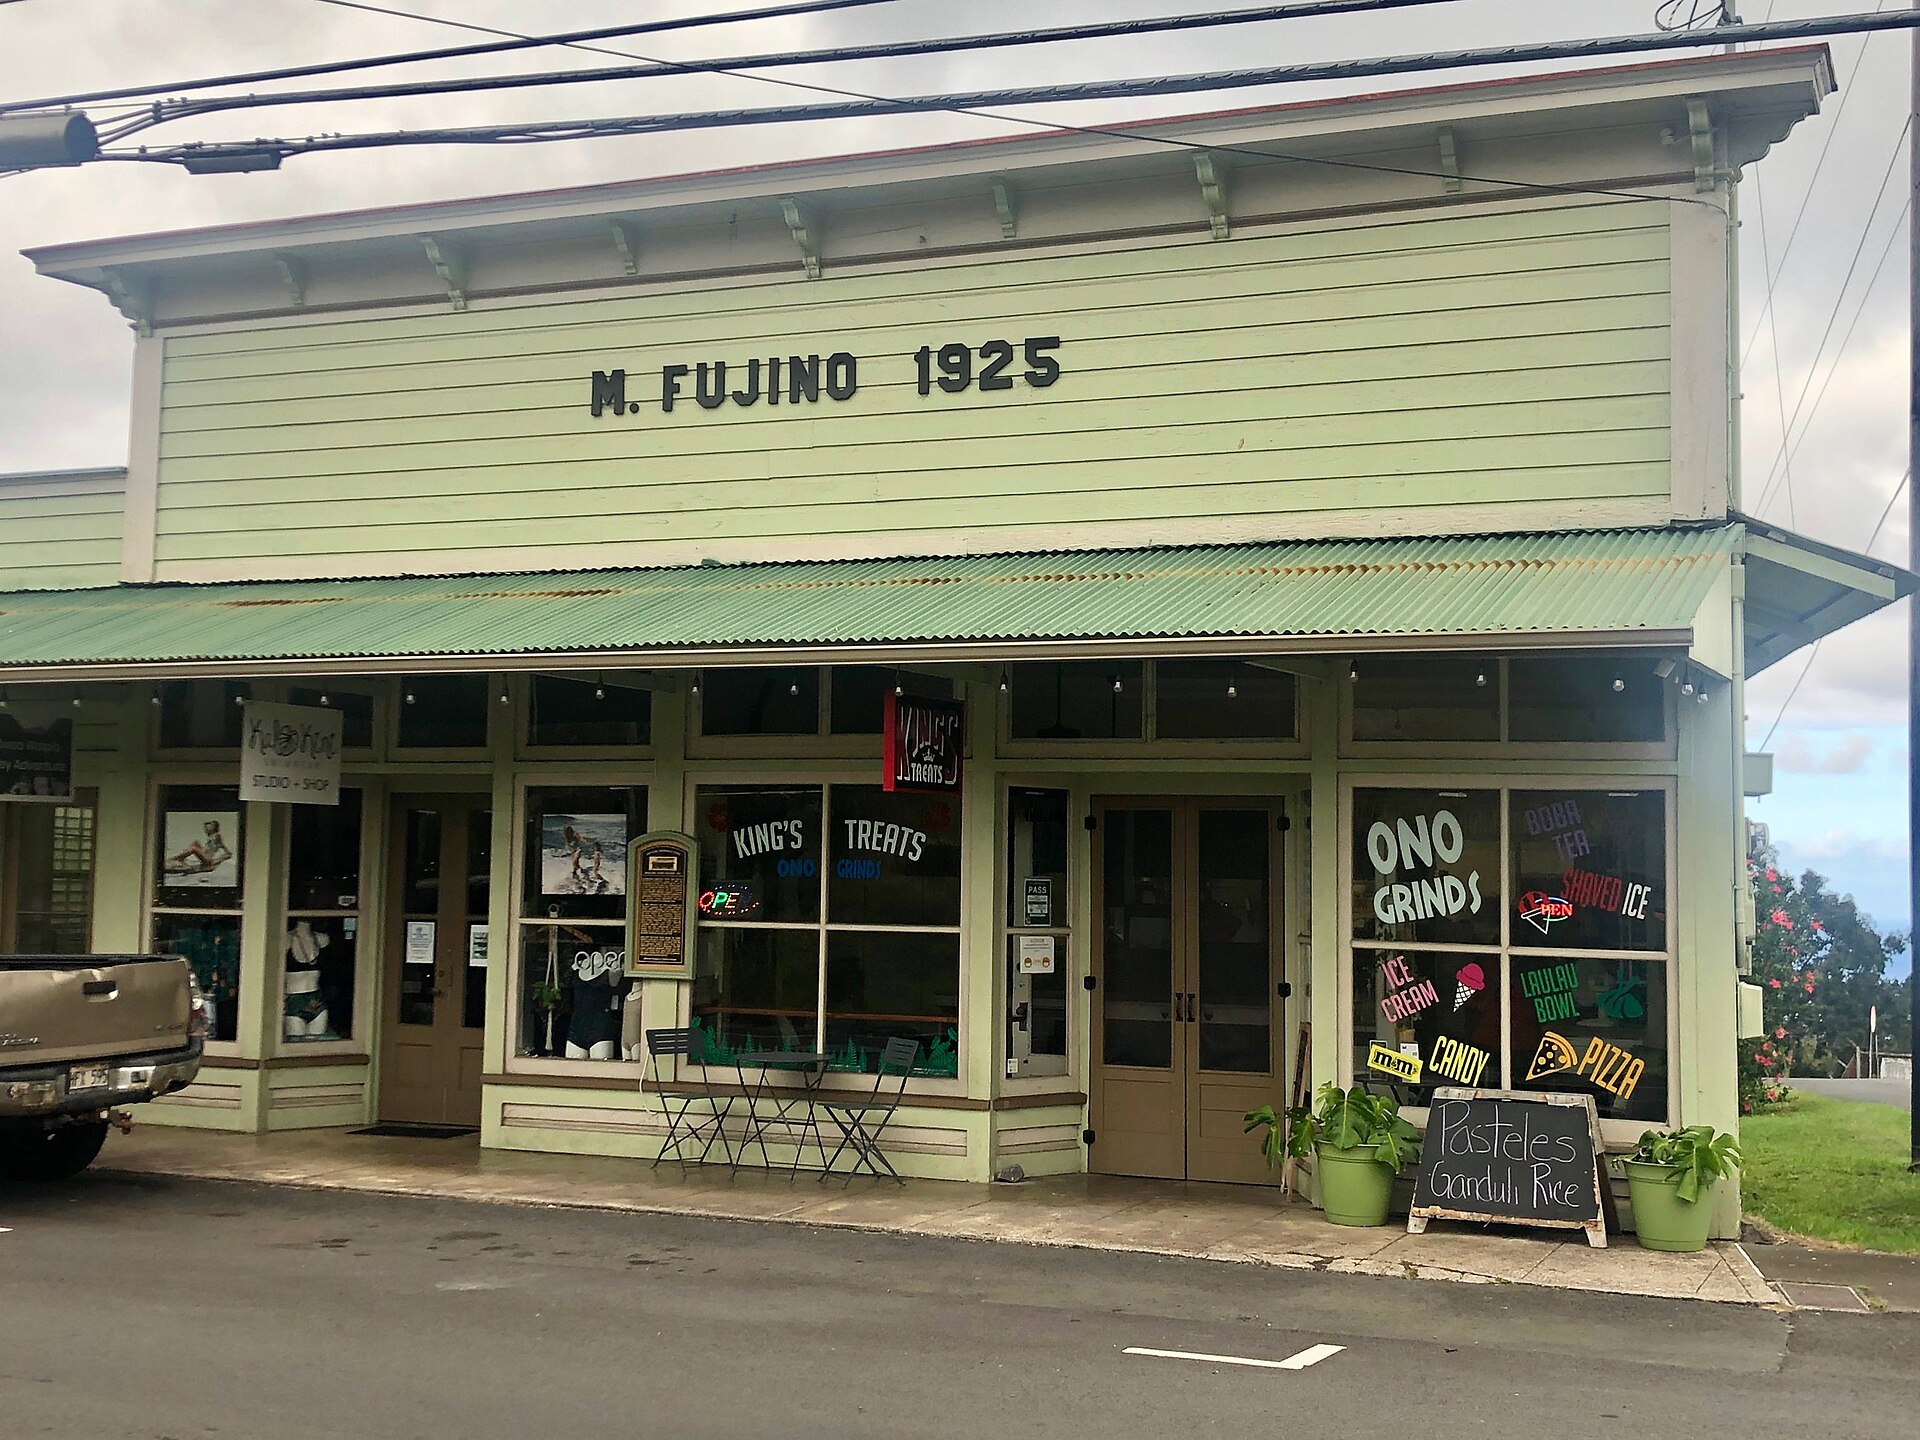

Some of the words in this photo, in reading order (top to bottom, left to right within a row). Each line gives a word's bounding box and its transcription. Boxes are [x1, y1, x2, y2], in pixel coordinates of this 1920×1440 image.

[590, 368, 640, 417] M.
[662, 351, 857, 412] FUJINO
[913, 335, 1061, 396] 1925
[252, 774, 290, 789] STUDIO
[302, 778, 329, 791] SHOP
[910, 762, 943, 784] TREATS
[1524, 799, 1582, 836] BOBA
[733, 820, 803, 859] KING'S
[845, 819, 927, 862] TREATS
[1367, 809, 1464, 875] ONO
[1552, 829, 1591, 860] TEA
[777, 858, 815, 879] ONO
[836, 858, 882, 881] GRINDS
[1028, 886, 1047, 894] PASS
[1373, 870, 1482, 924] GRINDS
[1540, 903, 1574, 917] PEN
[1560, 866, 1622, 913] SHAVED
[1621, 882, 1652, 920] ICE
[1381, 955, 1414, 990] ICE
[1520, 963, 1579, 998] LAULAU
[1380, 980, 1440, 1024] CREAM
[1533, 991, 1581, 1024] BOWL
[1428, 1035, 1491, 1088] CANDY
[1576, 1036, 1646, 1101] PIZZA
[1438, 1100, 1577, 1163] Pasteles
[1530, 1162, 1580, 1209] Rice
